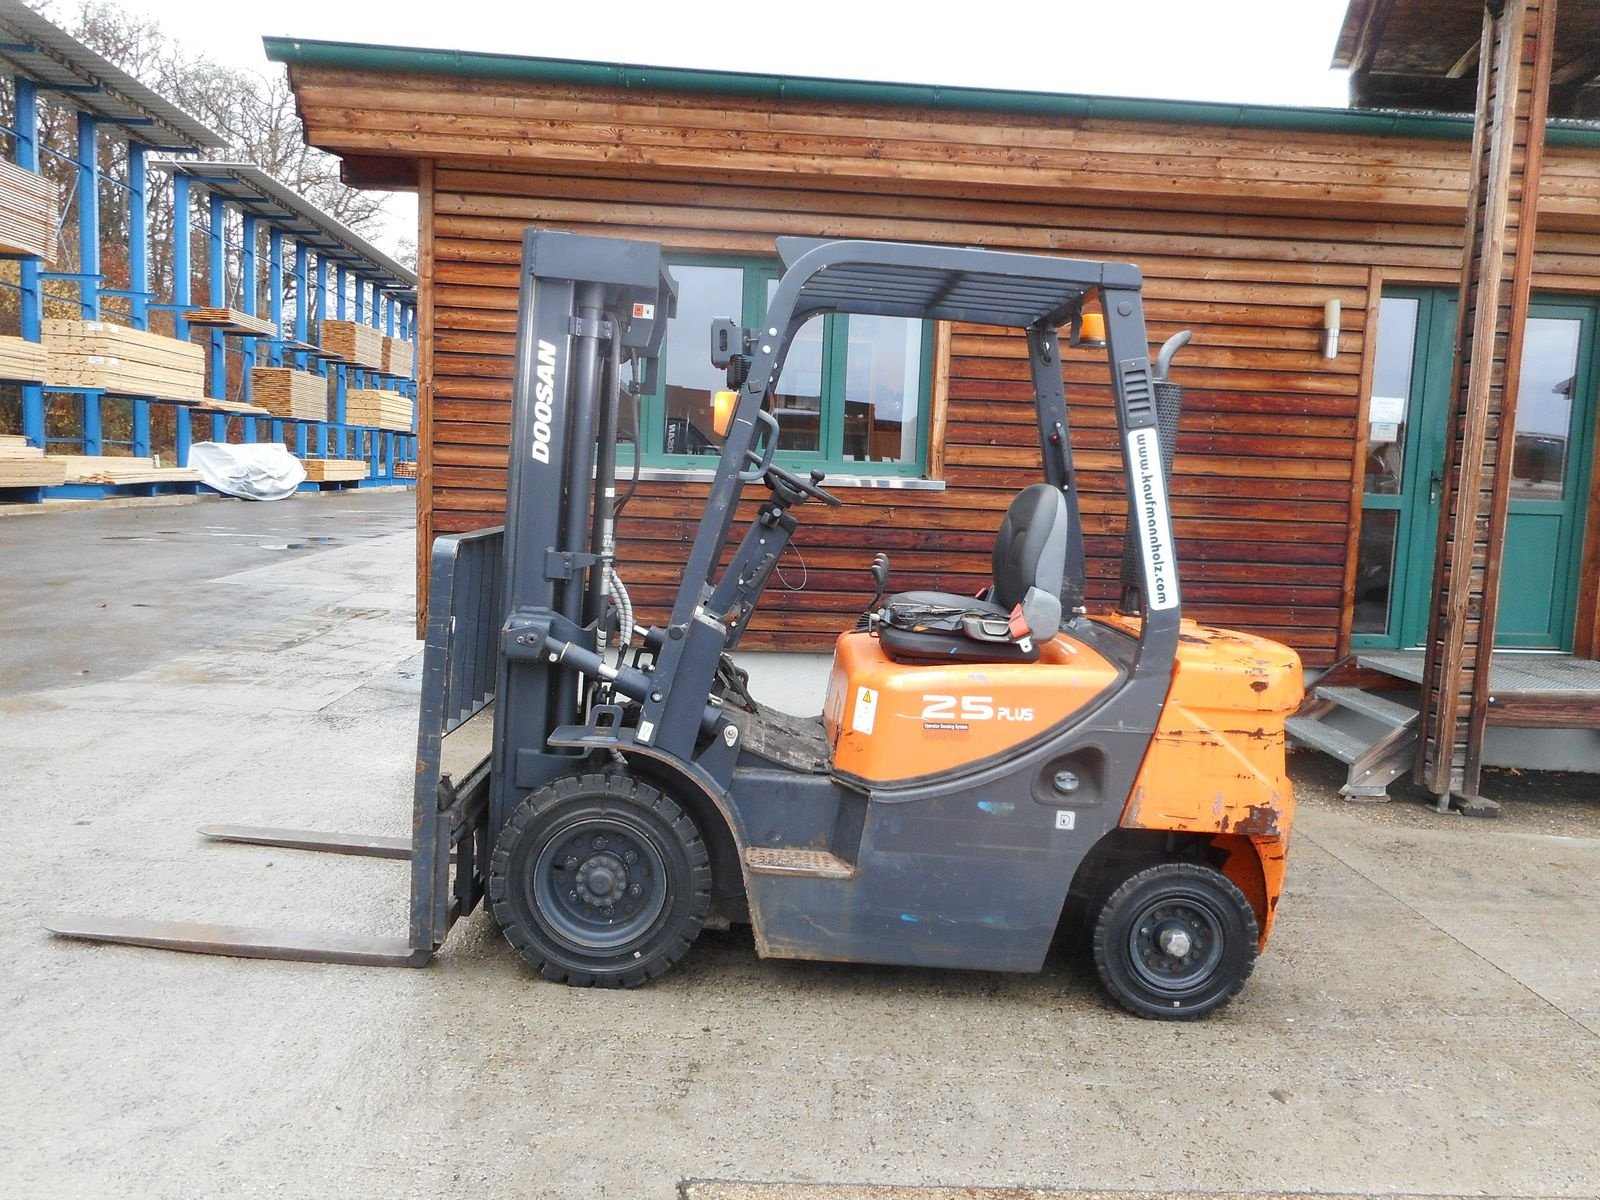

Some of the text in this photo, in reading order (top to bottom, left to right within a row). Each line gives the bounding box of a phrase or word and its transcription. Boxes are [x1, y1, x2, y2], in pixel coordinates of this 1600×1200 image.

[532, 339, 556, 465] DOOSAN
[1136, 433, 1166, 604] www.kaufmannholz.com
[921, 694, 1034, 721] 25 PLUS
